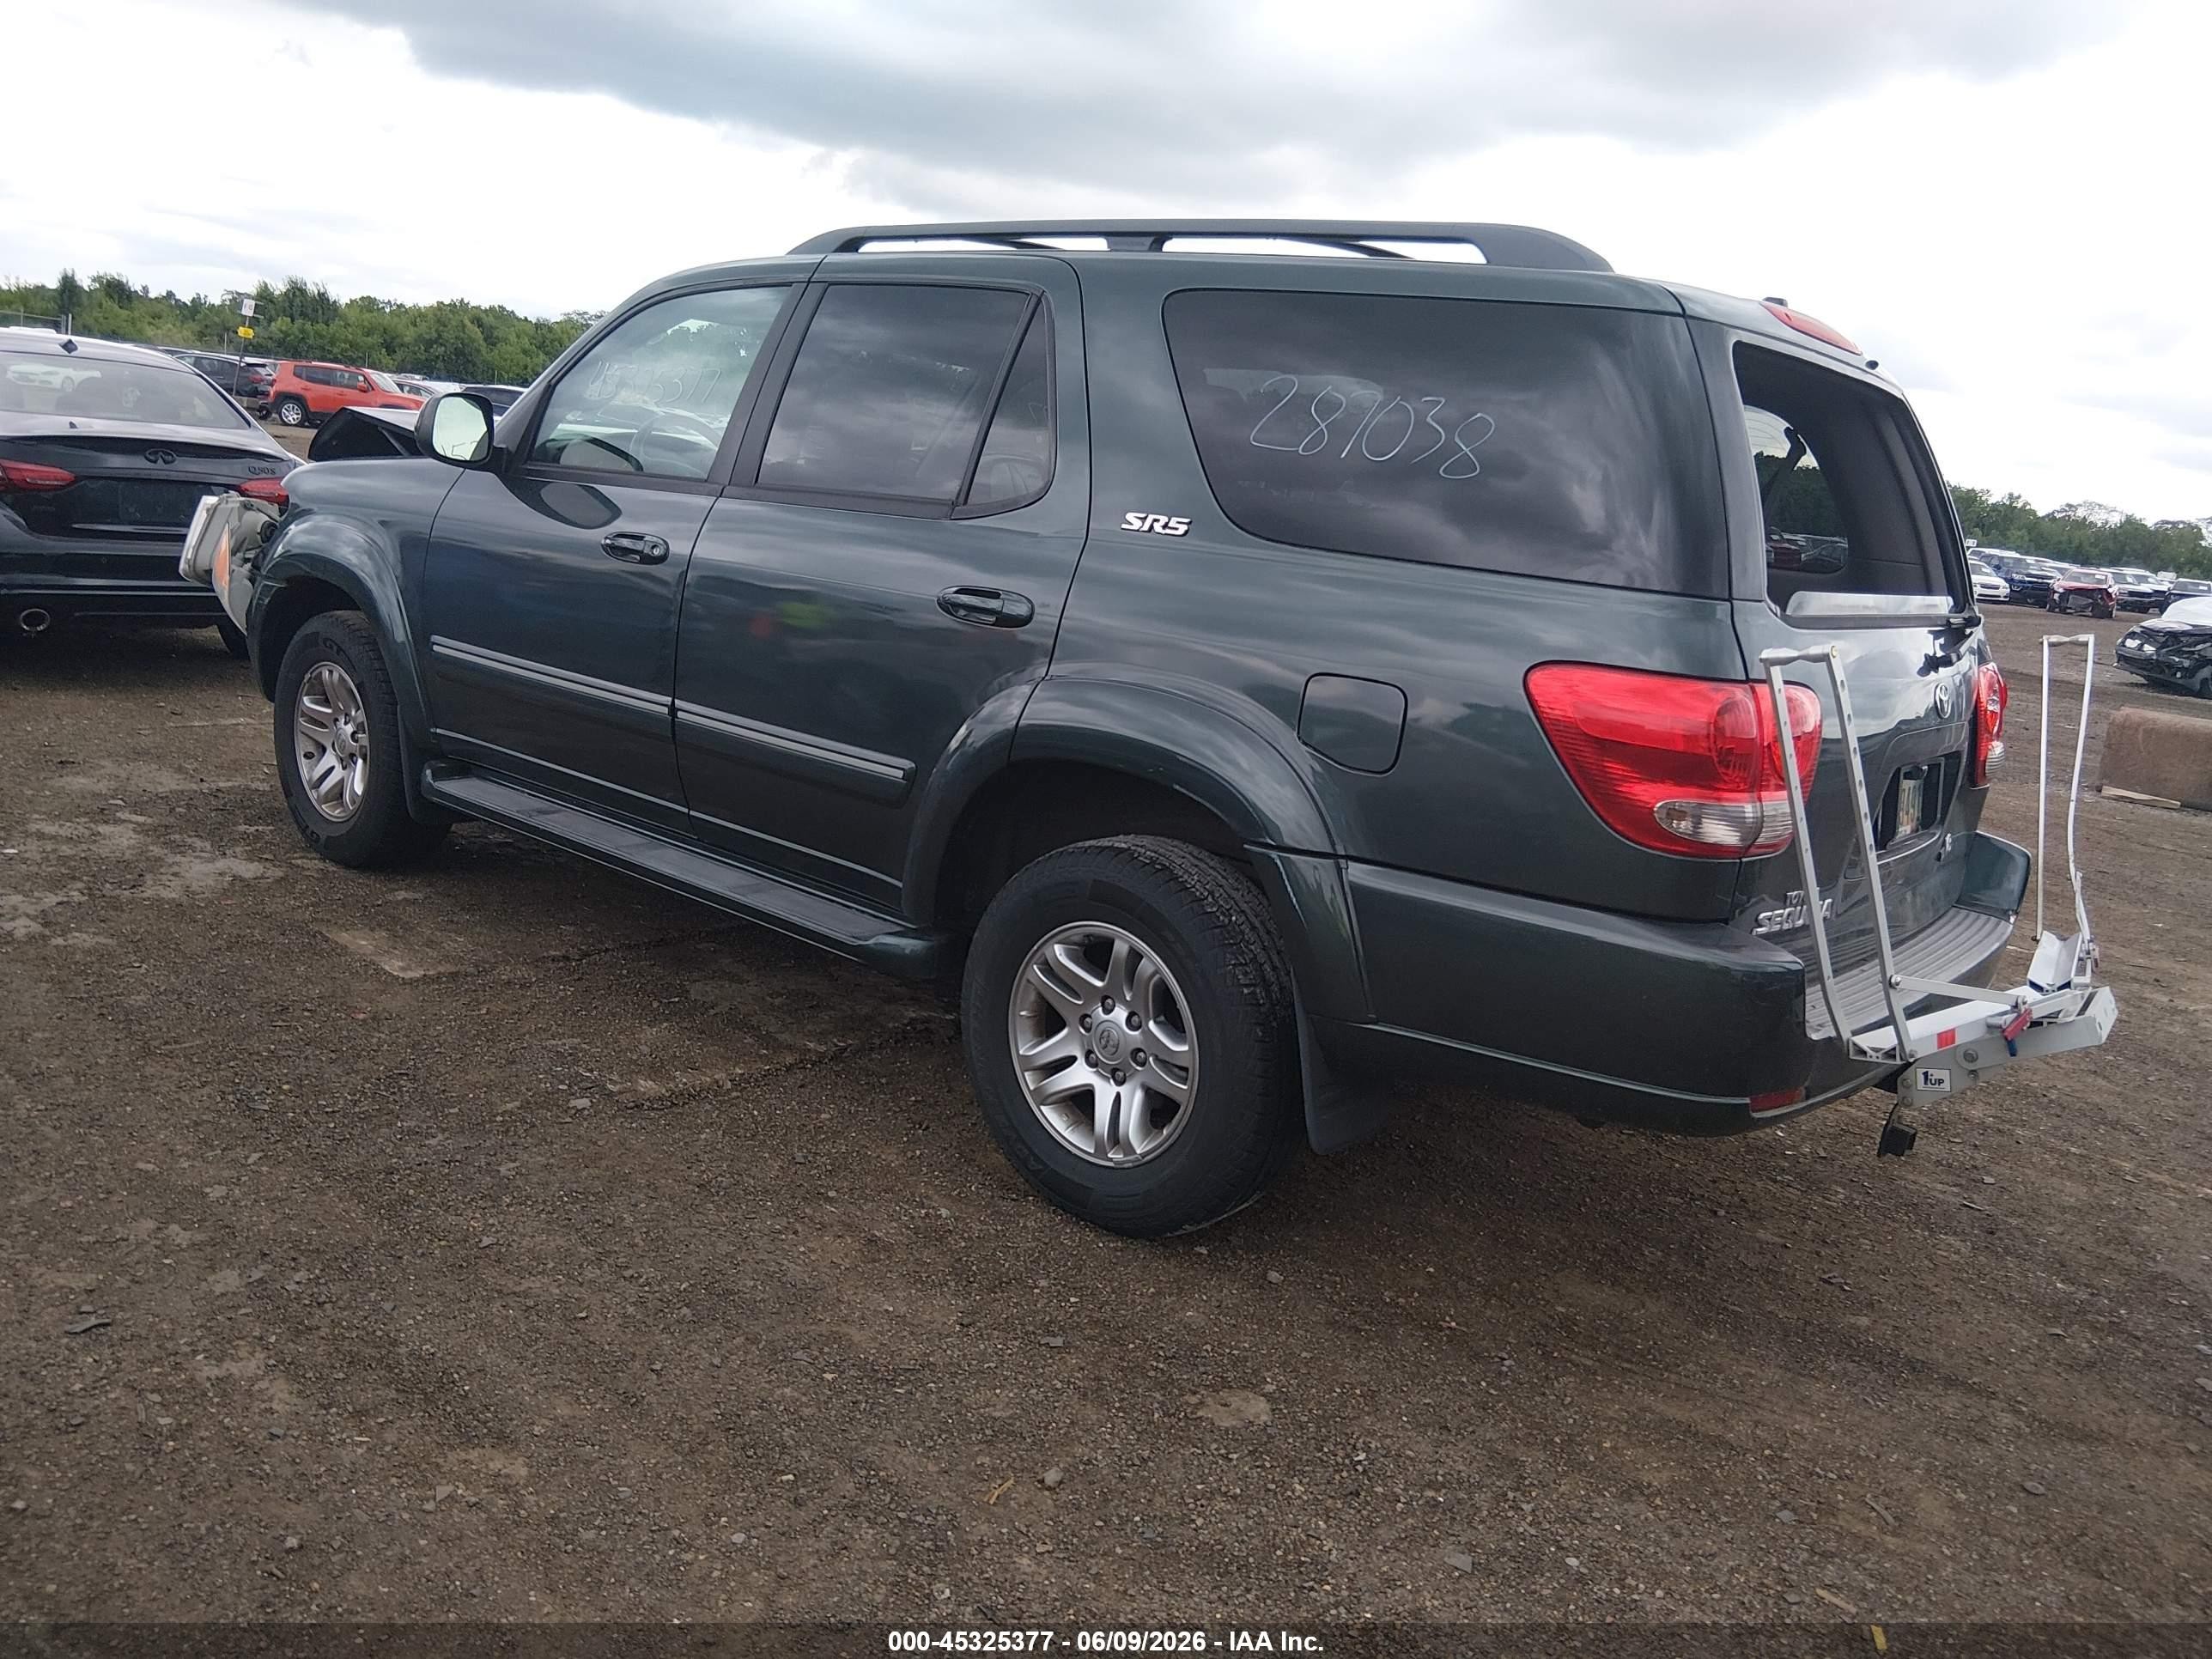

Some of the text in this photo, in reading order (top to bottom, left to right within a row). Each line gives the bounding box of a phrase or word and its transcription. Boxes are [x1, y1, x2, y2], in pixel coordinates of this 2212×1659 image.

[1249, 374, 1496, 479] 287038
[1120, 512, 1192, 538] SR5
[1752, 898, 1832, 936] SEQUA
